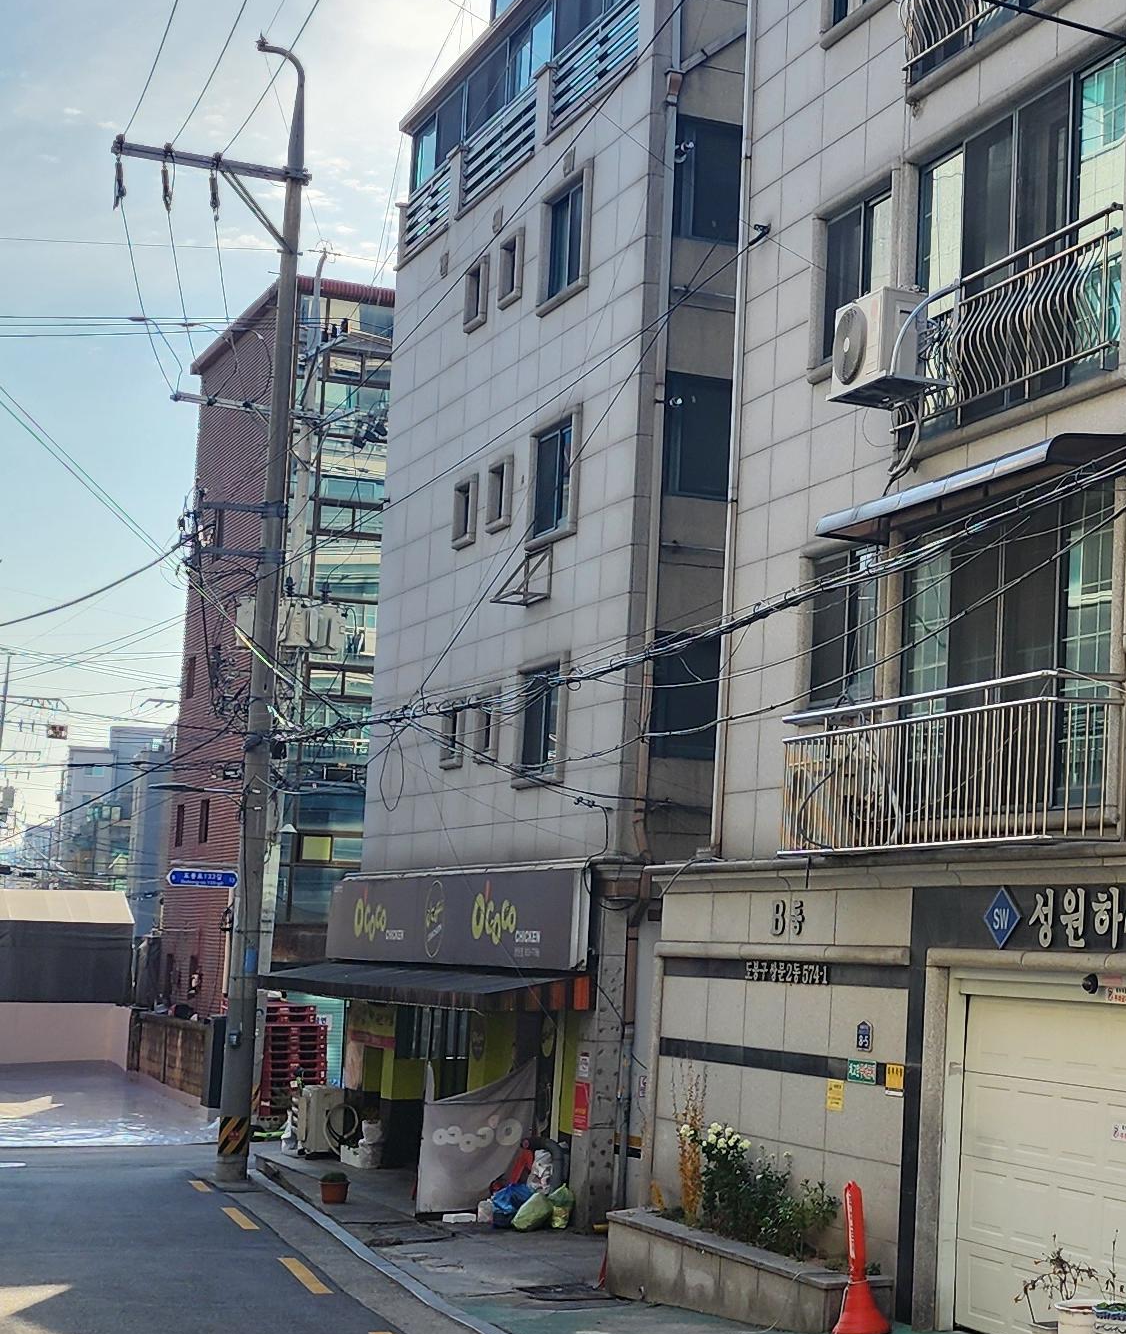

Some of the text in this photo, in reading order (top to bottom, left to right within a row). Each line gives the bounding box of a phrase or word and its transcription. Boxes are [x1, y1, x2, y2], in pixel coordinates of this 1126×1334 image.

[992, 908, 1010, 930] SW
[744, 960, 769, 981] 도봉구
[801, 964, 828, 985] 574-1
